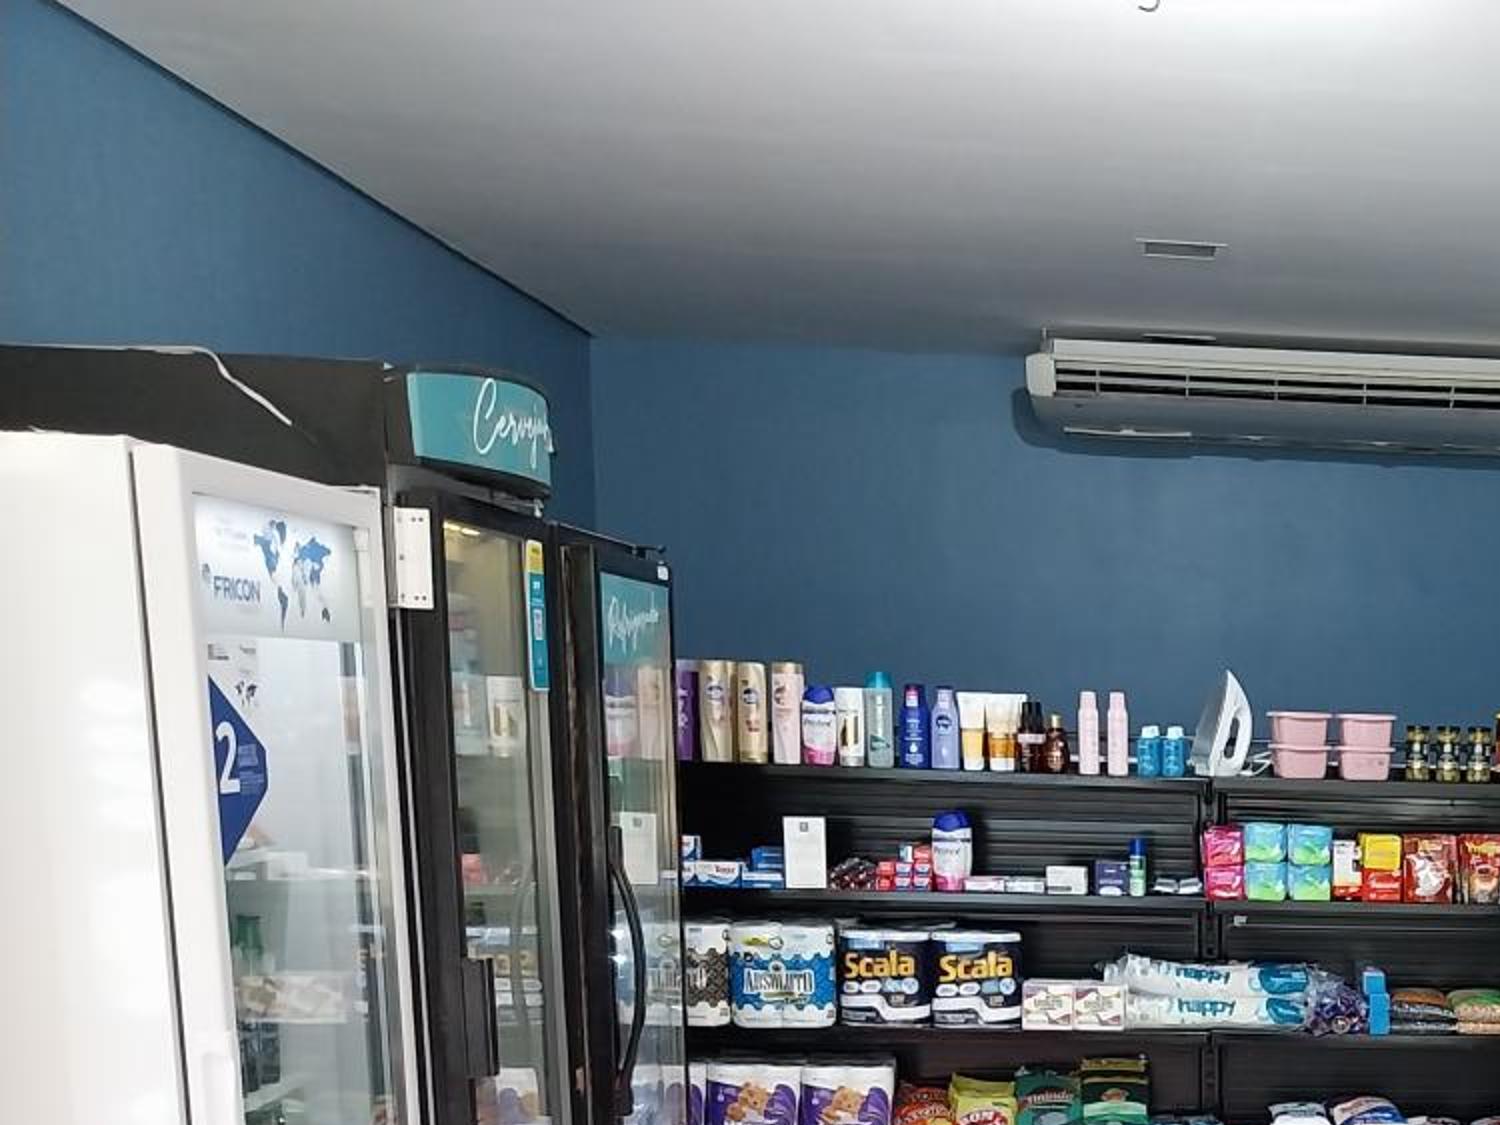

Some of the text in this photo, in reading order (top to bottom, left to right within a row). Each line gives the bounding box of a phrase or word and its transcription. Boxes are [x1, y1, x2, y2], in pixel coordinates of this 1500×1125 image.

[212, 575, 261, 603] FRICON
[215, 721, 241, 795] 2
[845, 949, 915, 978] Scala
[939, 950, 1013, 983] Scala
[1178, 999, 1237, 1017] happy
